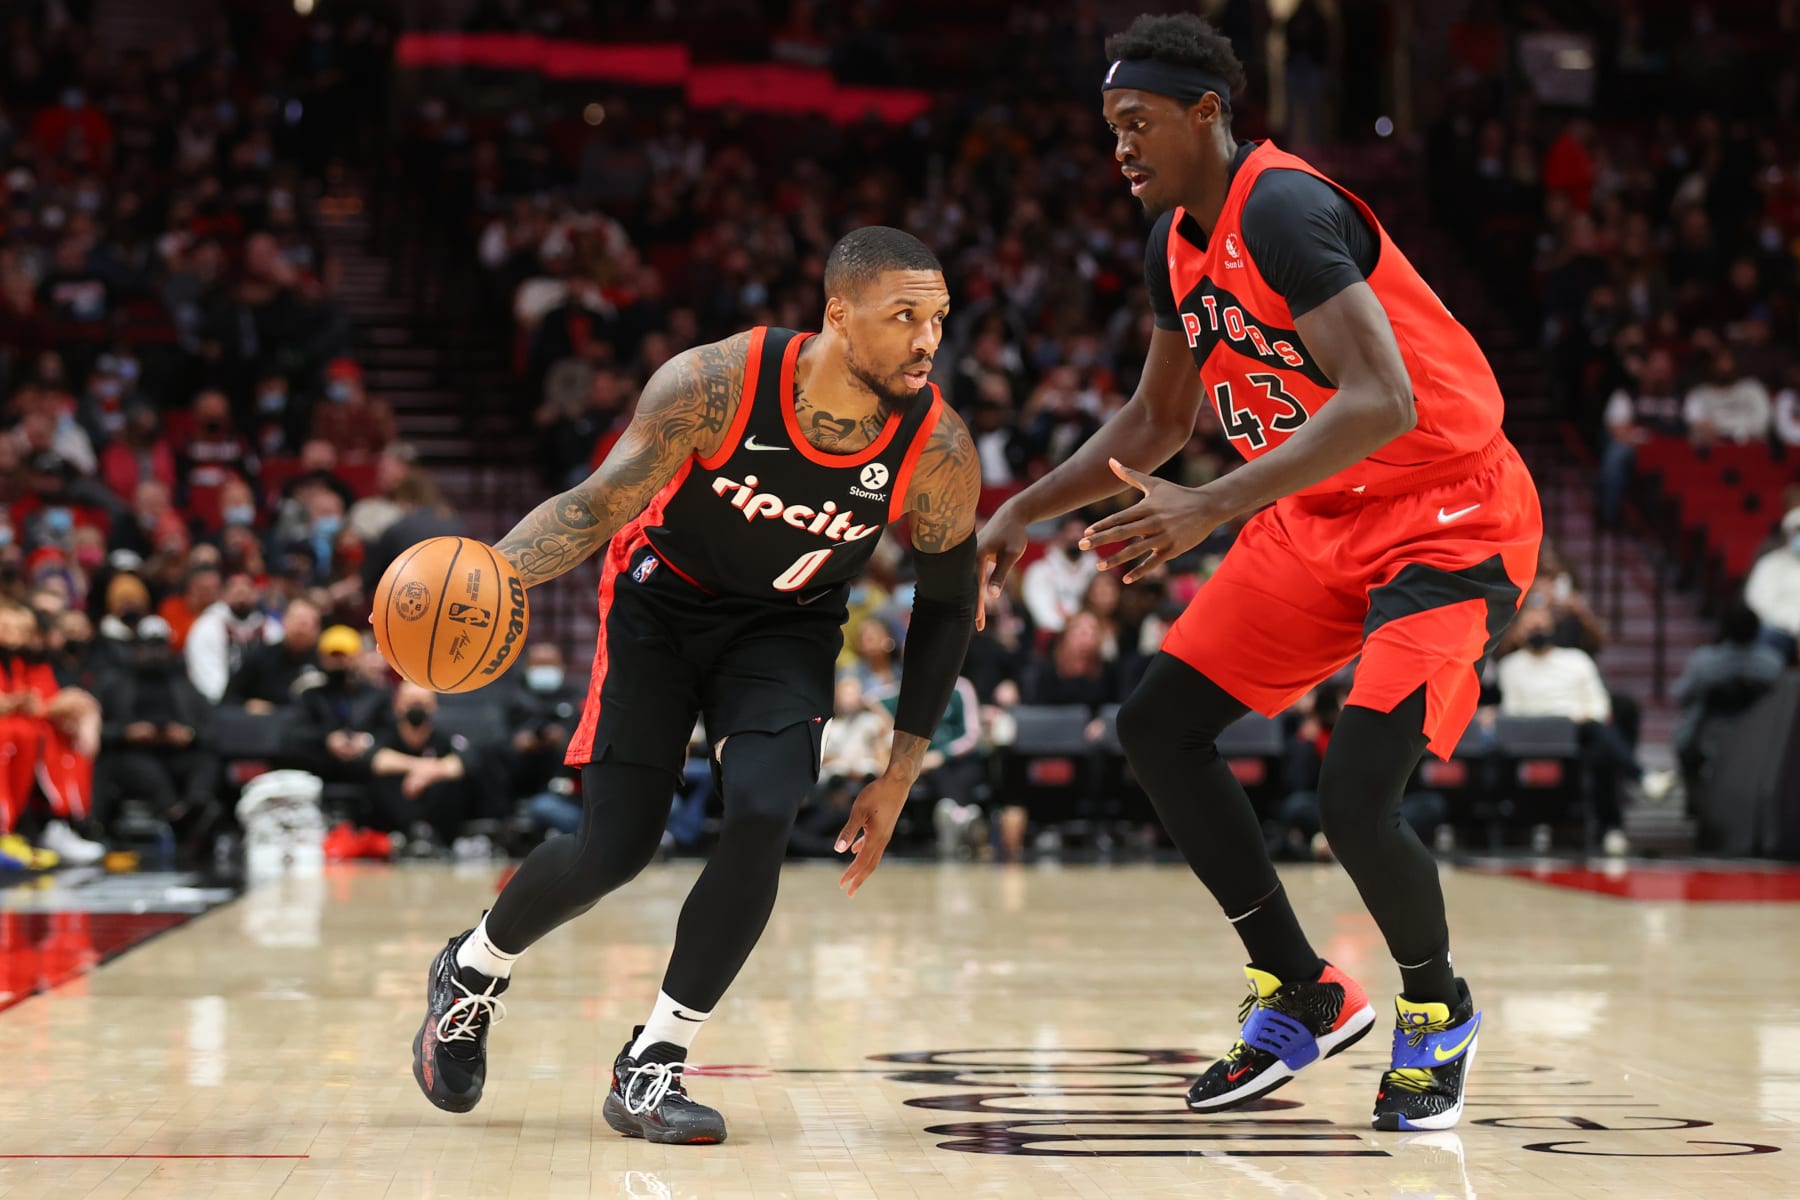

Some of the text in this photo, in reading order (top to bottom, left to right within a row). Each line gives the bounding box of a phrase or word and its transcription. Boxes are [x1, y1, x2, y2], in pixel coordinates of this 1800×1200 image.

[1181, 295, 1304, 367] PTORS
[1214, 372, 1310, 450] 43
[849, 485, 887, 502] StormX
[772, 548, 833, 592] 0
